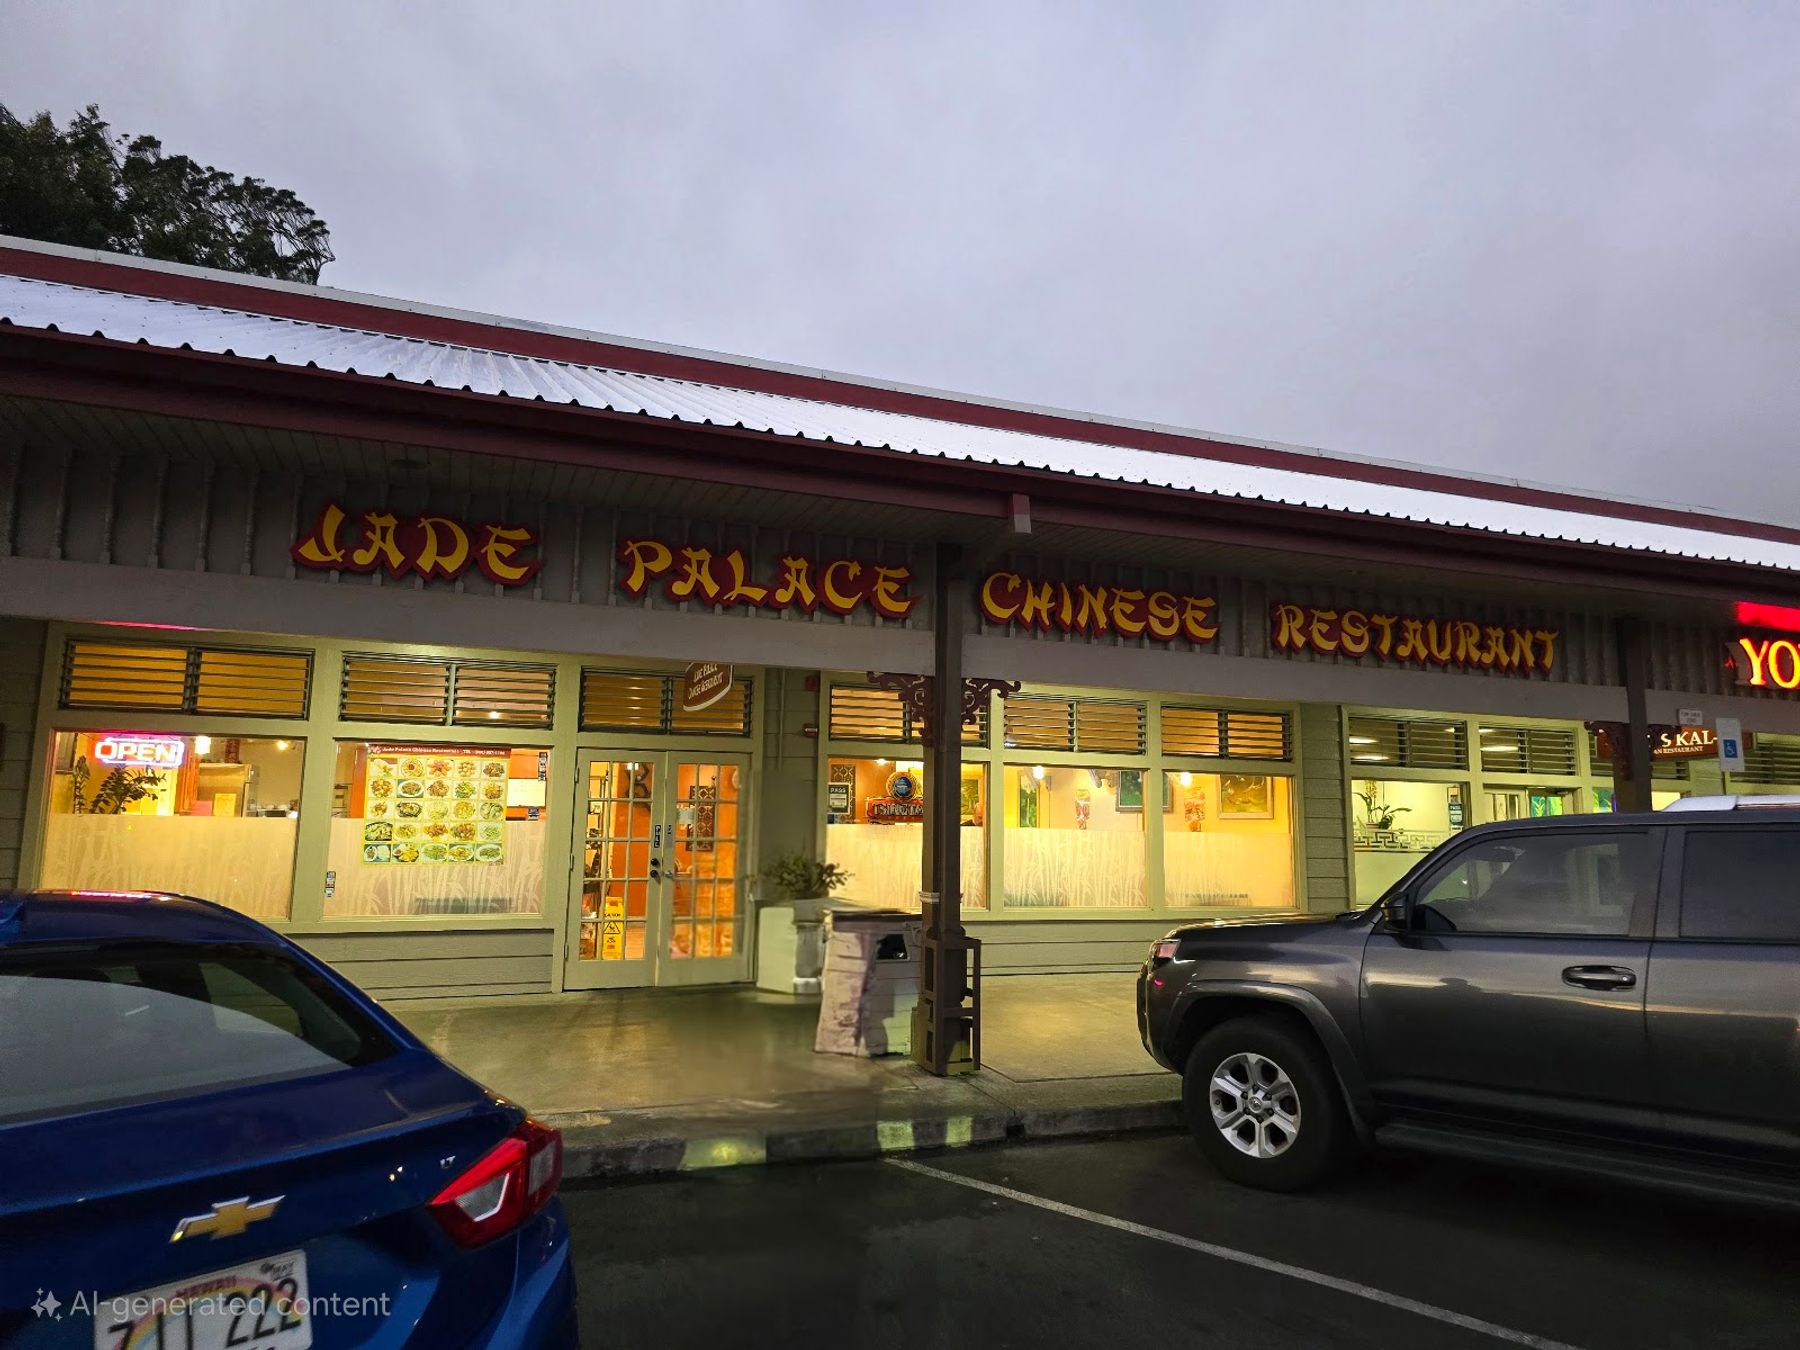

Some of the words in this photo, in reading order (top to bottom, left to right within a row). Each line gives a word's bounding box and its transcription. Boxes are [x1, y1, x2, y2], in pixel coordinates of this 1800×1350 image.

[298, 503, 532, 581] JADE
[623, 539, 912, 613] PALACE
[981, 576, 1219, 640] CHINESE
[1275, 603, 1559, 670] RESTAURANT
[1738, 637, 1800, 690] YO
[1675, 729, 1718, 746] KAL-
[94, 741, 178, 763] OPEN
[1663, 746, 1704, 754] RESTAURANT
[874, 803, 924, 816] TSINGTA
